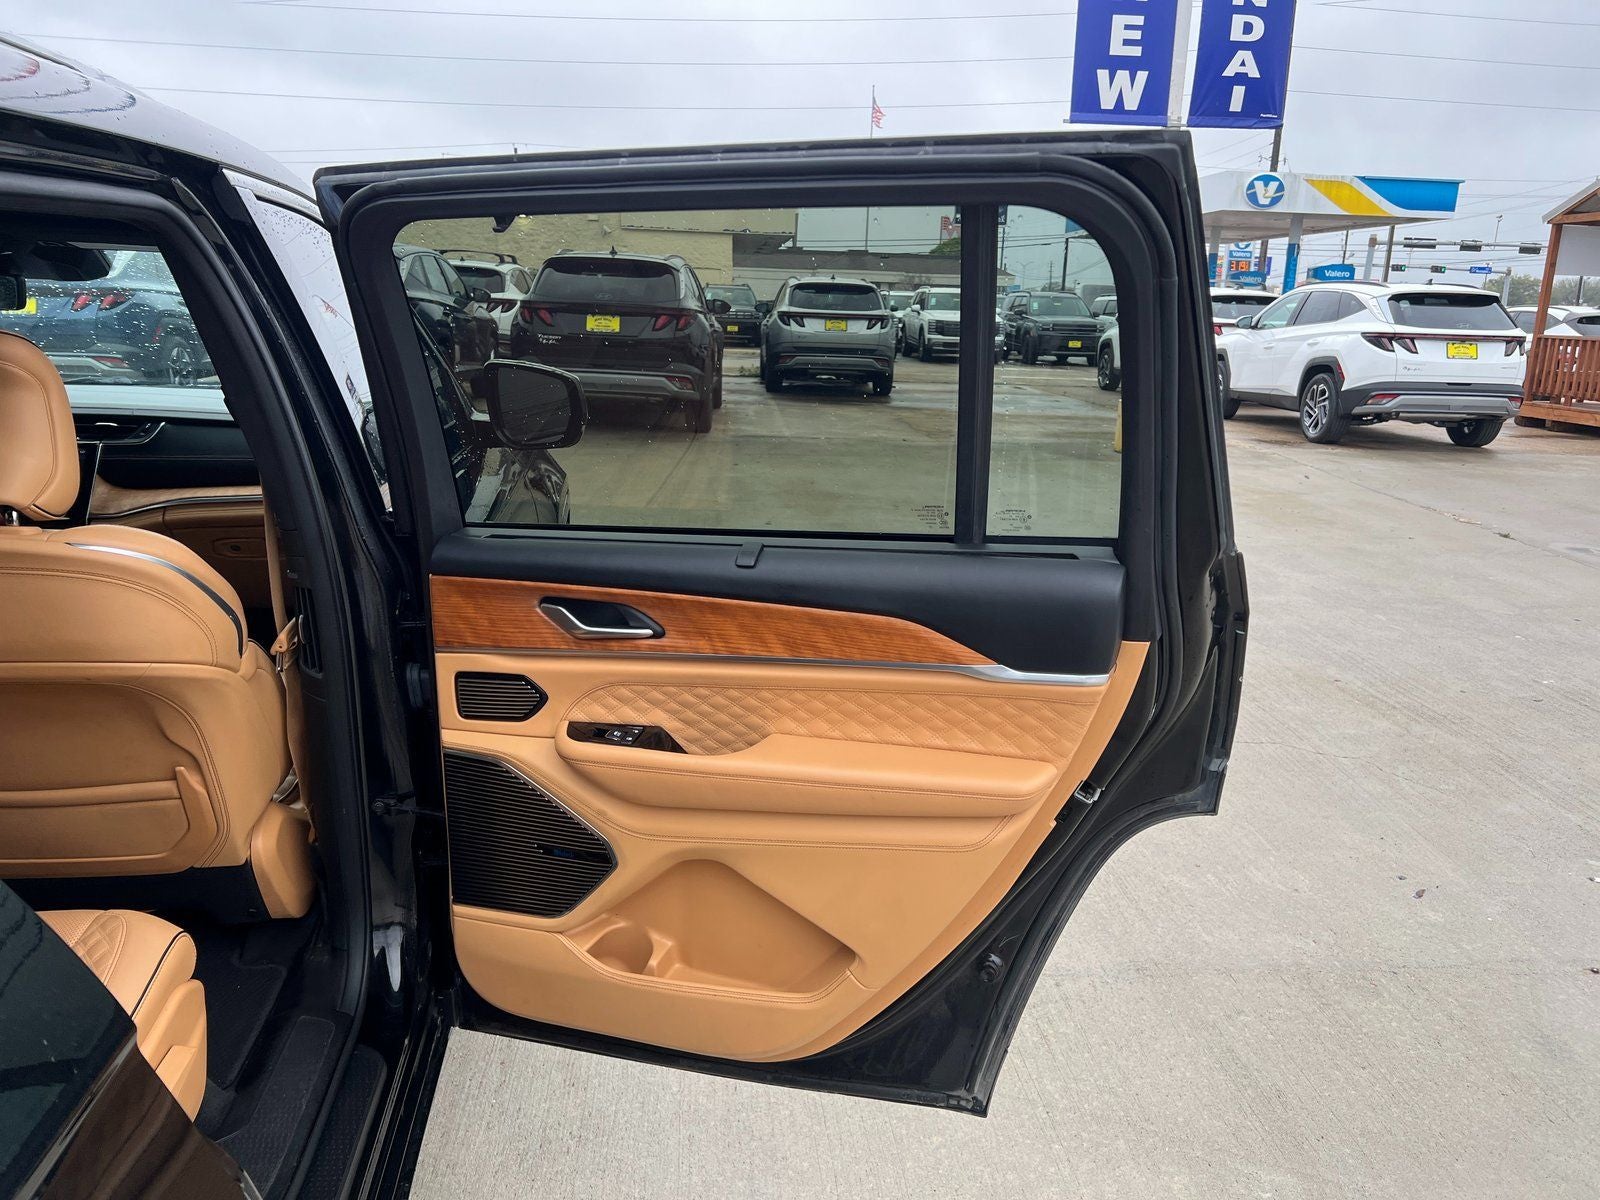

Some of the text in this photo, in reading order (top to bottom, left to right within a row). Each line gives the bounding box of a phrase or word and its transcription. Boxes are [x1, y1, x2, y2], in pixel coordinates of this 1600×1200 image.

[1096, 0, 1149, 111] EW
[1221, 0, 1268, 112] DAI
[1239, 275, 1262, 283] Valero
[1324, 269, 1350, 278] Valero
